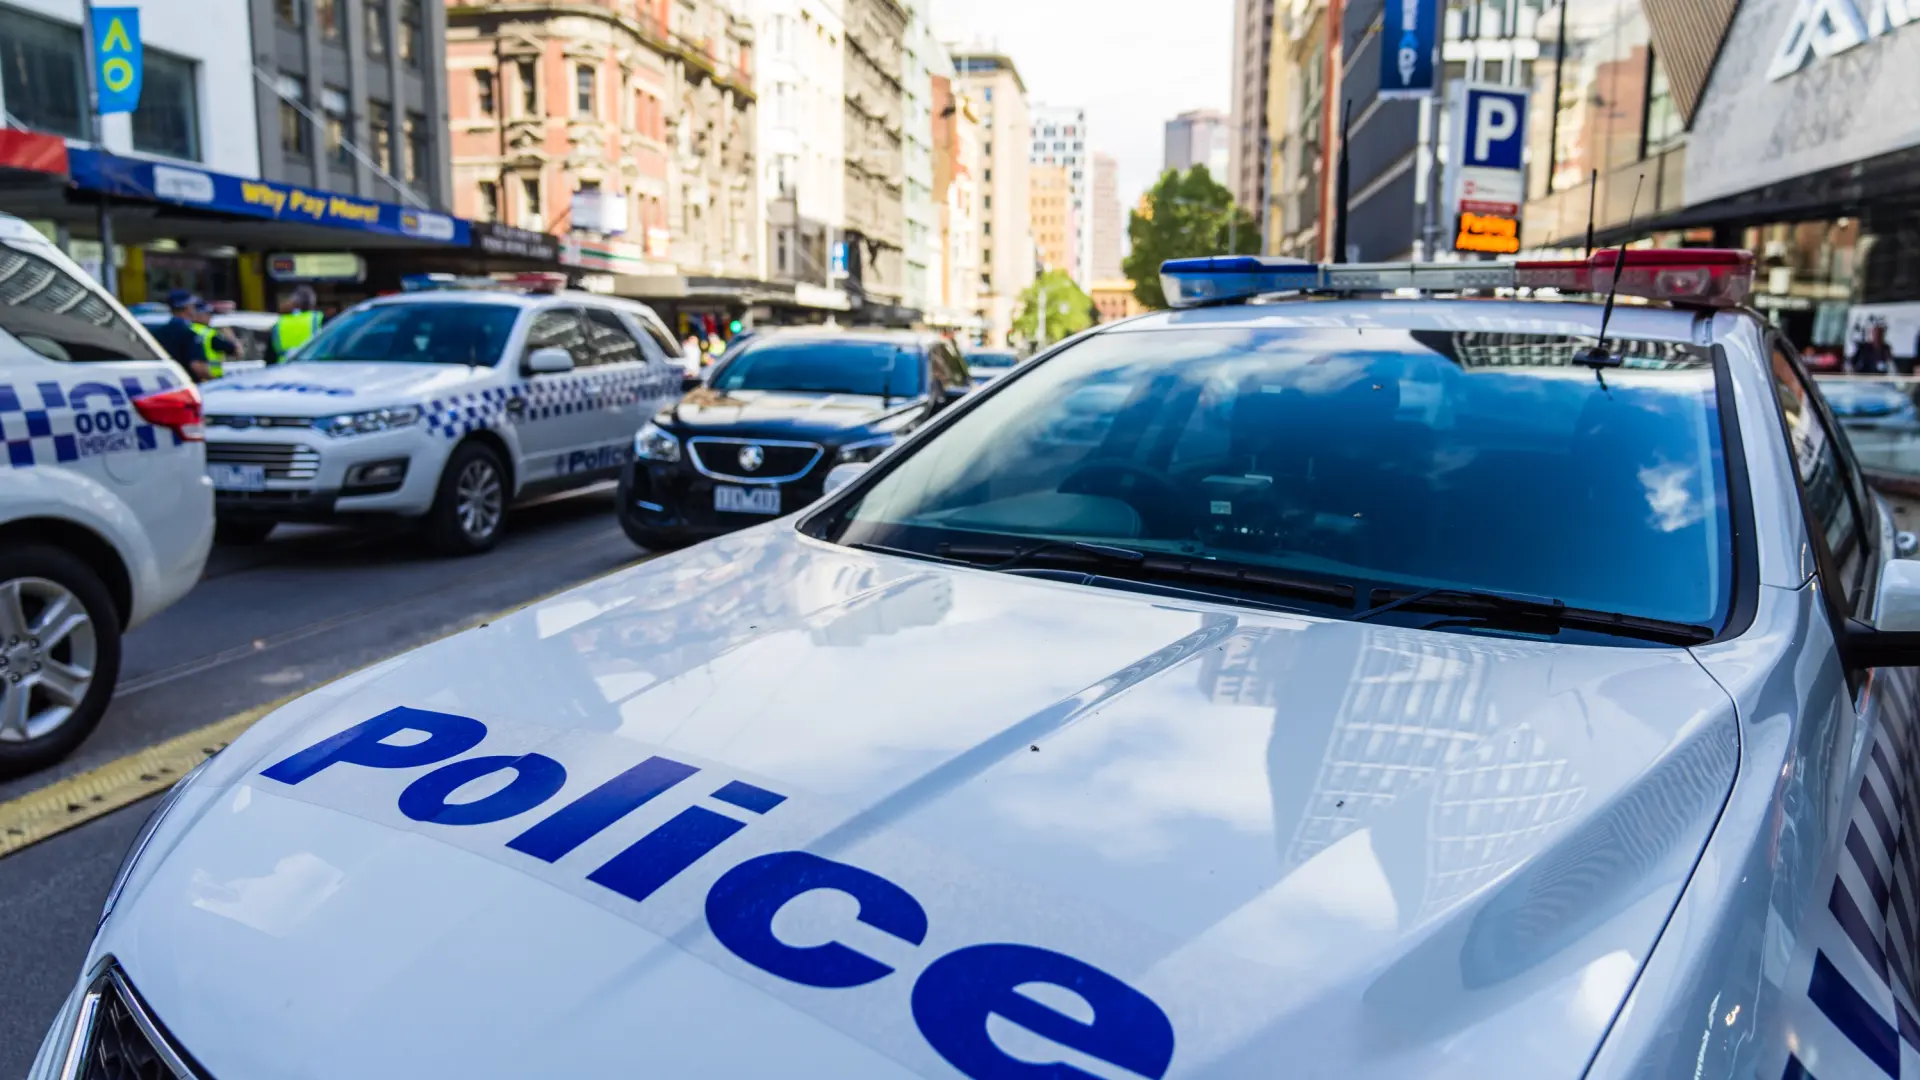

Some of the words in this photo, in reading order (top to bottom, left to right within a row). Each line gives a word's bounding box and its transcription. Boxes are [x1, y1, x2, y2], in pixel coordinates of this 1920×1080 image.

[1474, 95, 1518, 162] P
[241, 181, 286, 218] Why
[289, 189, 327, 220] Pay
[75, 409, 131, 435] 000
[258, 706, 1175, 1080] Police
